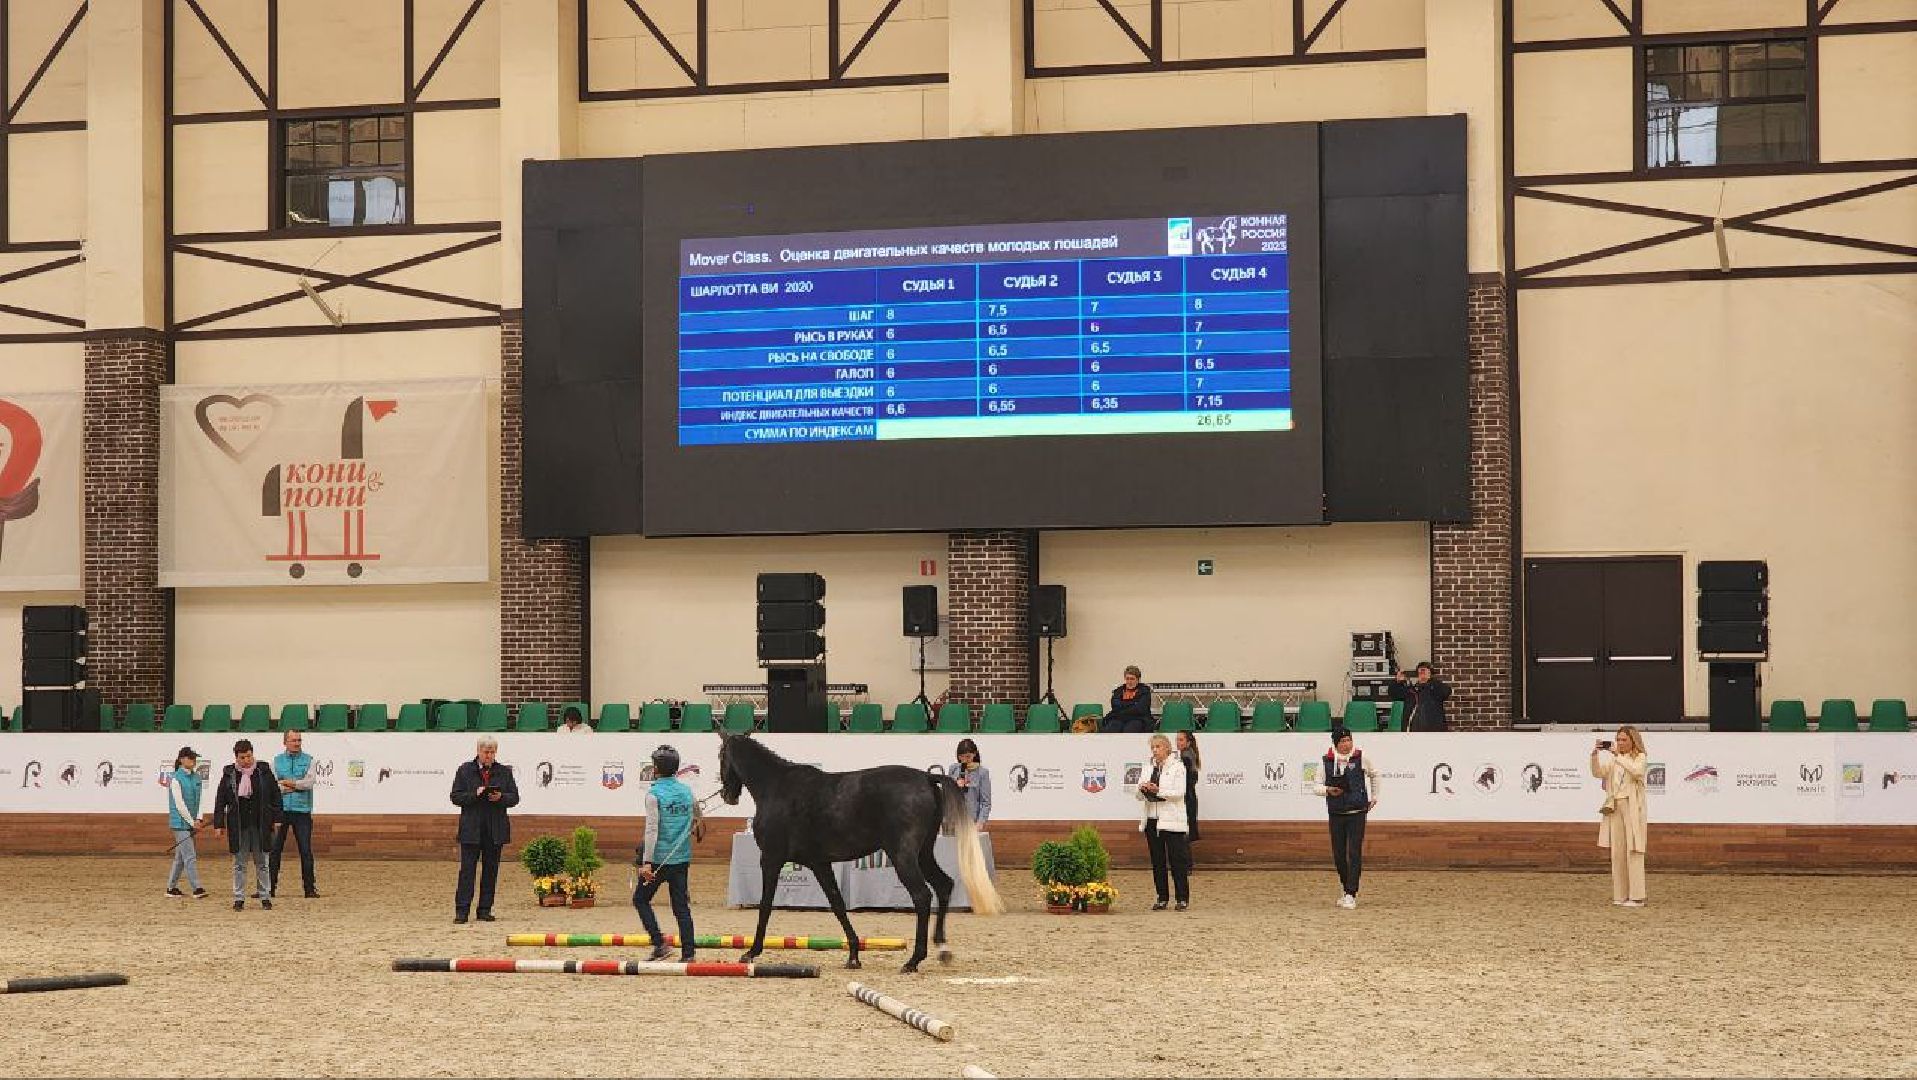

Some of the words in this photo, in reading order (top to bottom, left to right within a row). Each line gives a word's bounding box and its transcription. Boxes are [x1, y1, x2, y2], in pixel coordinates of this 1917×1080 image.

[1241, 215, 1286, 226] КОННАЯ
[1242, 229, 1286, 239] РОССИЯ
[689, 253, 729, 266] Mover
[732, 251, 772, 264] Class.
[780, 249, 830, 263] Оценка
[833, 245, 928, 261] двигательных
[931, 242, 984, 254] качеств
[988, 240, 1051, 253] молодых
[1054, 235, 1118, 250] лошадей
[1107, 271, 1151, 284] СУДЬЯ
[1153, 270, 1163, 282] 3
[1211, 267, 1256, 281] СУДЬЯ
[1258, 267, 1268, 279] 4
[902, 279, 945, 292] СУДЬЯ
[948, 278, 955, 290] 1
[1003, 275, 1047, 289] СУДЬЯ
[1049, 275, 1059, 287] 2
[690, 283, 758, 297] ШАРЛОТТА
[761, 283, 779, 294] ВИ
[785, 281, 814, 293] 2020
[988, 304, 1007, 317] 7,5
[1090, 301, 1099, 313] 7
[1194, 298, 1203, 310] 8
[849, 310, 874, 322] ШАГ
[886, 309, 895, 320] 8
[1195, 321, 1203, 332] 7
[794, 331, 825, 343] РЫСЬ
[827, 331, 835, 341] В
[837, 329, 874, 341] РУКАХ
[1195, 339, 1203, 350] 7
[768, 352, 799, 363] РЫСЬ
[801, 351, 818, 361] НА
[819, 349, 874, 361] СВОБОДЕ
[836, 368, 874, 380] ГАЛОП
[988, 363, 998, 375] 6
[988, 383, 998, 394] 6
[1196, 377, 1204, 389] 7
[722, 389, 793, 402] ПОТЕНЦИАЛ
[794, 389, 818, 402] ДЛЯ
[820, 386, 874, 399] ВЫЕЗДКИ
[720, 409, 758, 421] ИНДЕКС
[759, 408, 830, 420] ДВИГАТЕЛЬНЫХ
[831, 406, 874, 417] КАЧЕСТВ
[744, 427, 787, 439] СУММА
[789, 427, 809, 438] ПО
[810, 425, 874, 438] ИНДЕКСАМ
[287, 462, 366, 483] кони
[284, 486, 366, 507] пони
